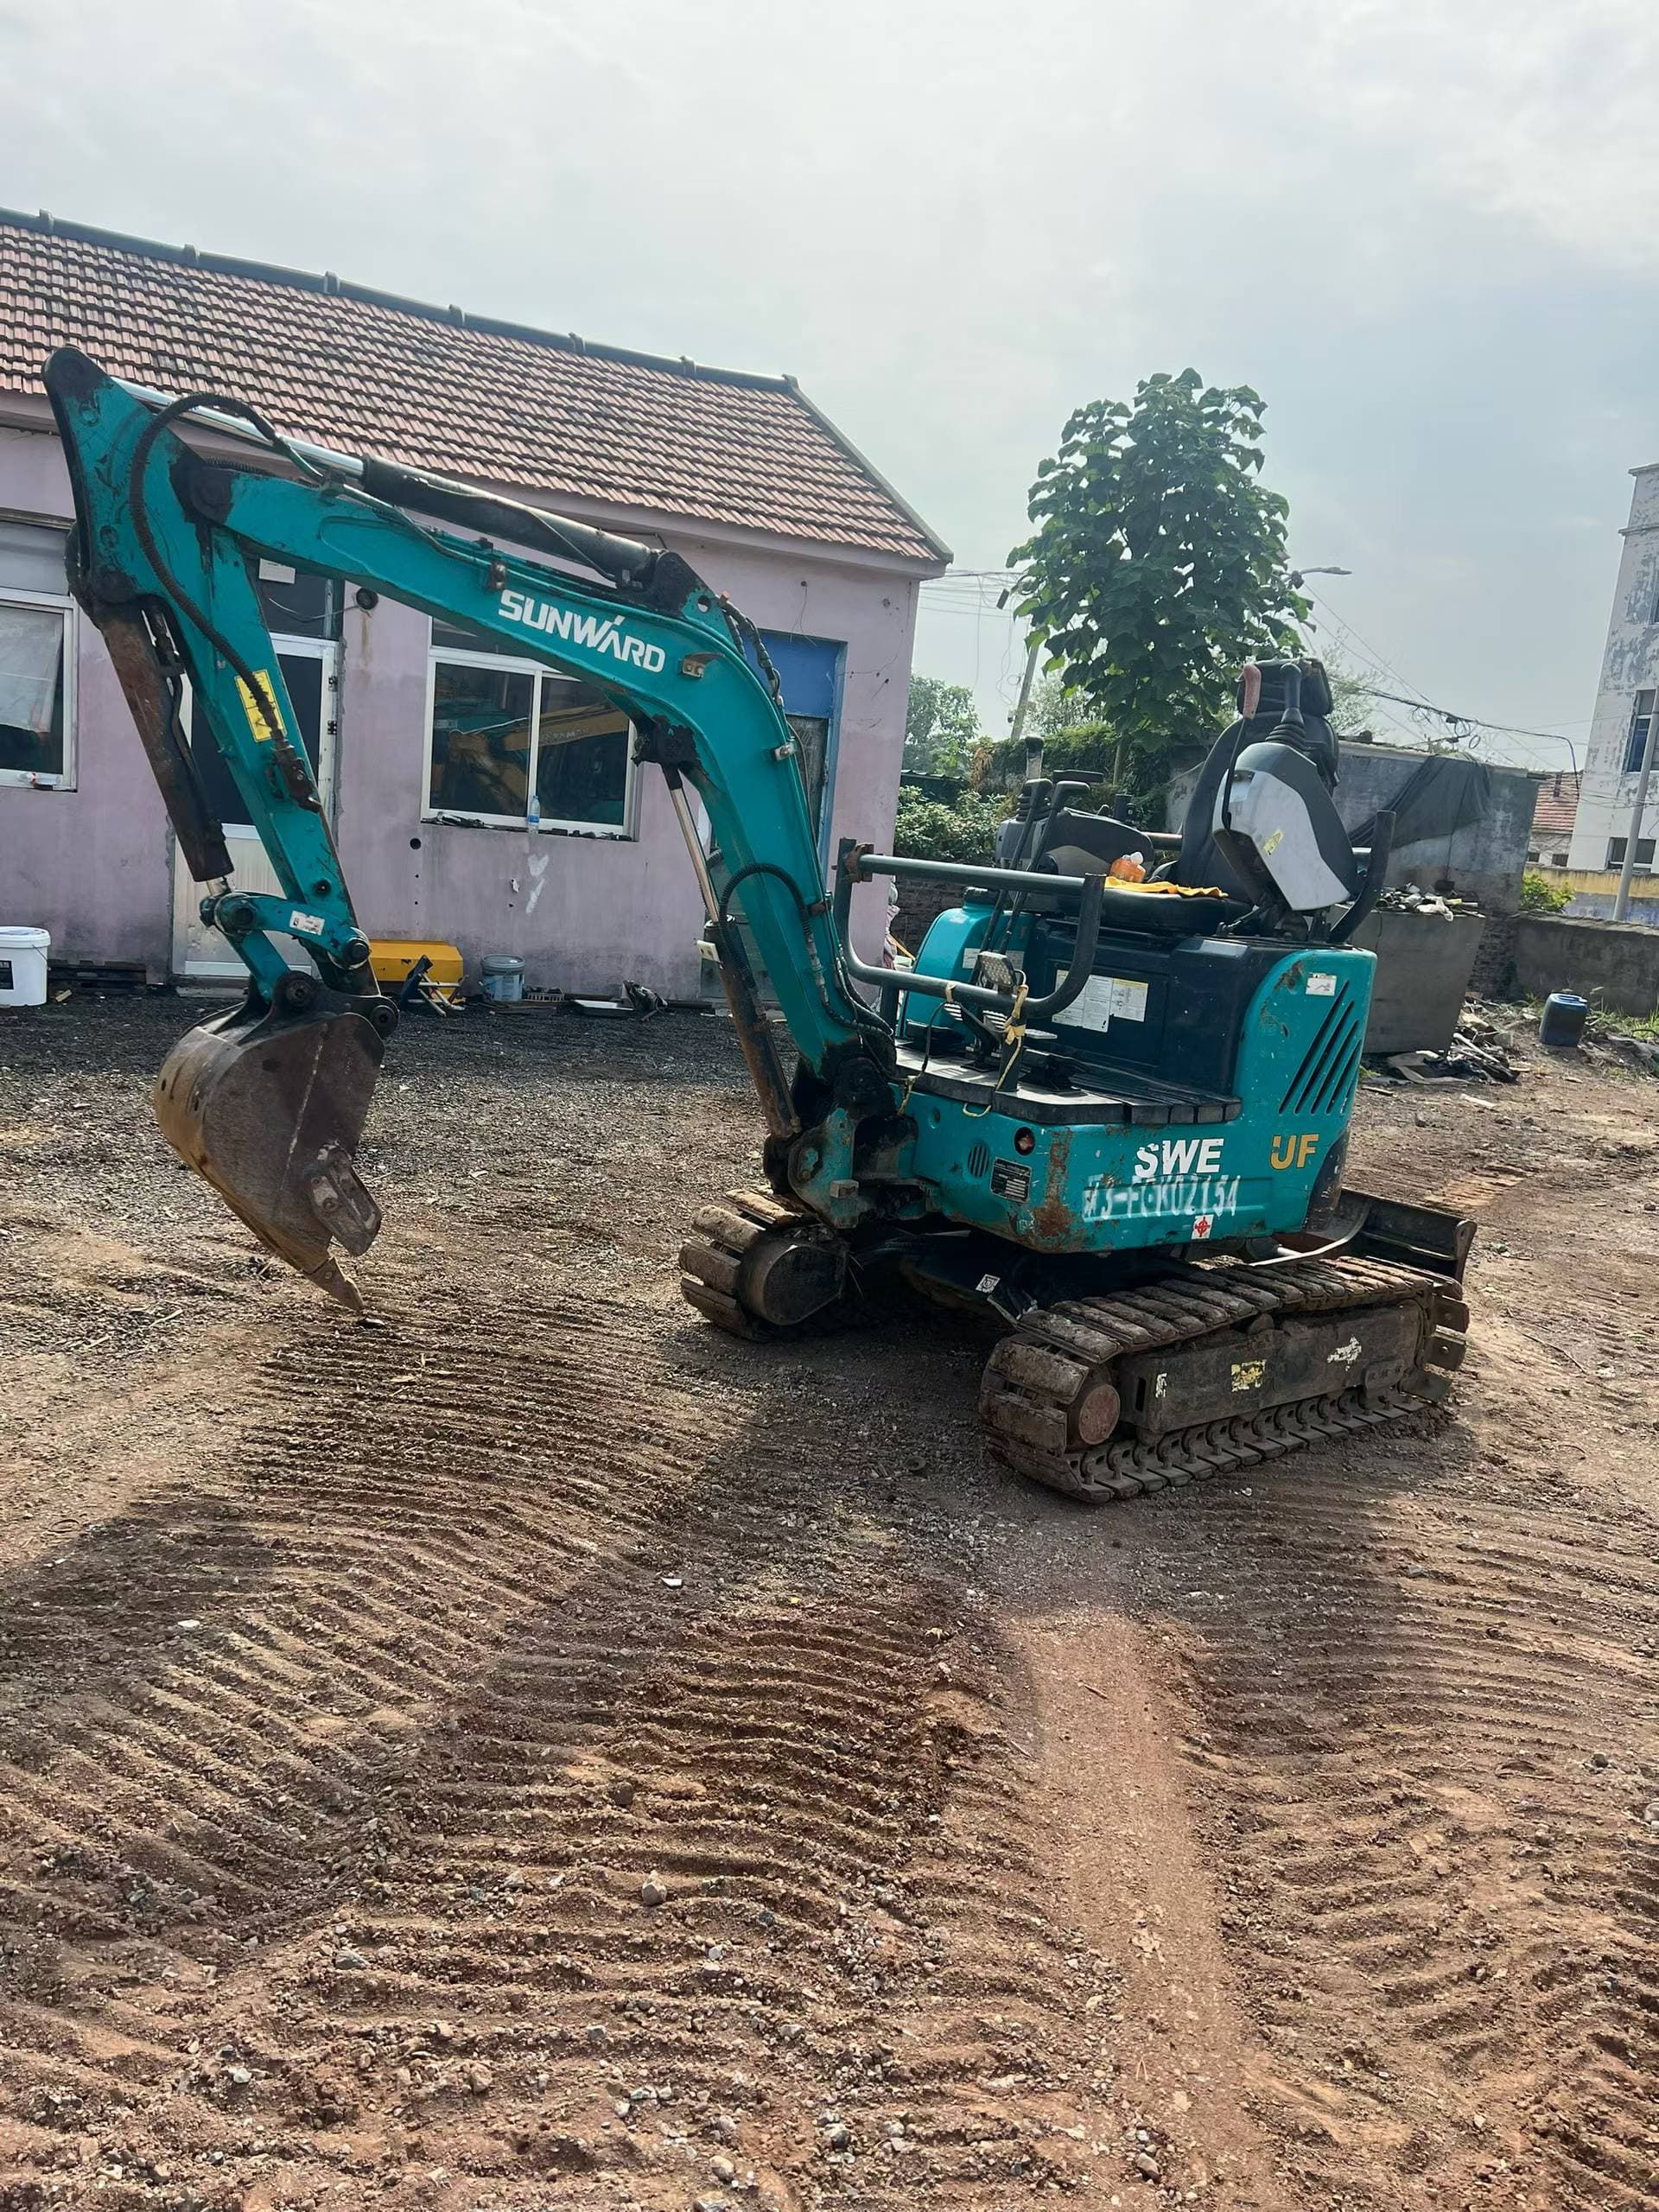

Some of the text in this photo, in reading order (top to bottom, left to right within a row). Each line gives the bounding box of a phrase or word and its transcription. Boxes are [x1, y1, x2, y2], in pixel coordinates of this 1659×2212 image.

[499, 588, 665, 673] SUNWARD
[1134, 1138, 1224, 1178] SWE
[1270, 1134, 1319, 1170] UF
